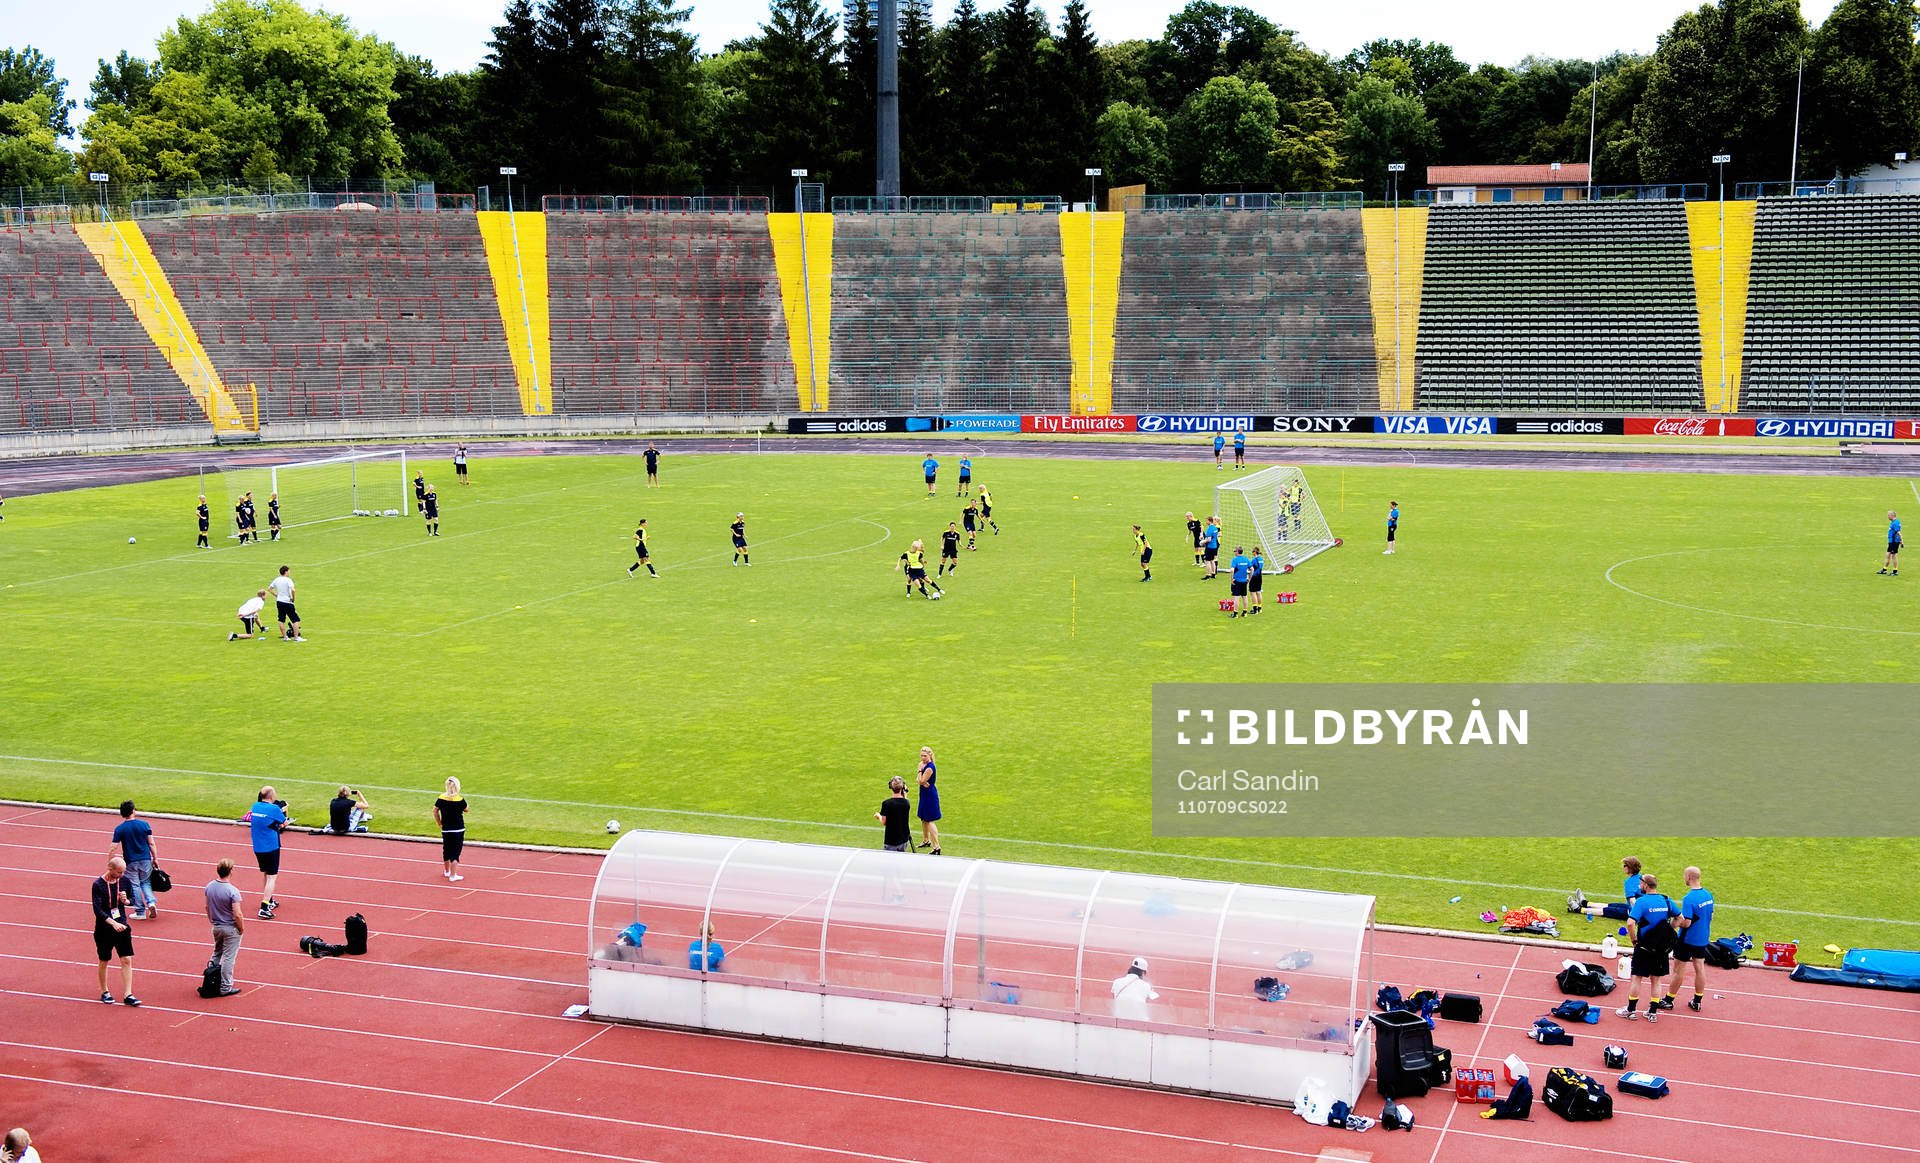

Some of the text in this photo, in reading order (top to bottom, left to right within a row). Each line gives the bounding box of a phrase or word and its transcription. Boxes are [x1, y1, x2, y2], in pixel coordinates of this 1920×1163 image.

[838, 419, 886, 432] adidas
[956, 420, 1018, 428] POWERADE
[1034, 416, 1125, 432] Fly Emirates
[1170, 417, 1254, 431] HYUNDAI
[1273, 416, 1355, 432] SONY
[1383, 416, 1492, 434] VISA VISA
[1550, 420, 1603, 433] adidas
[1794, 421, 1893, 437] HYUNDAI
